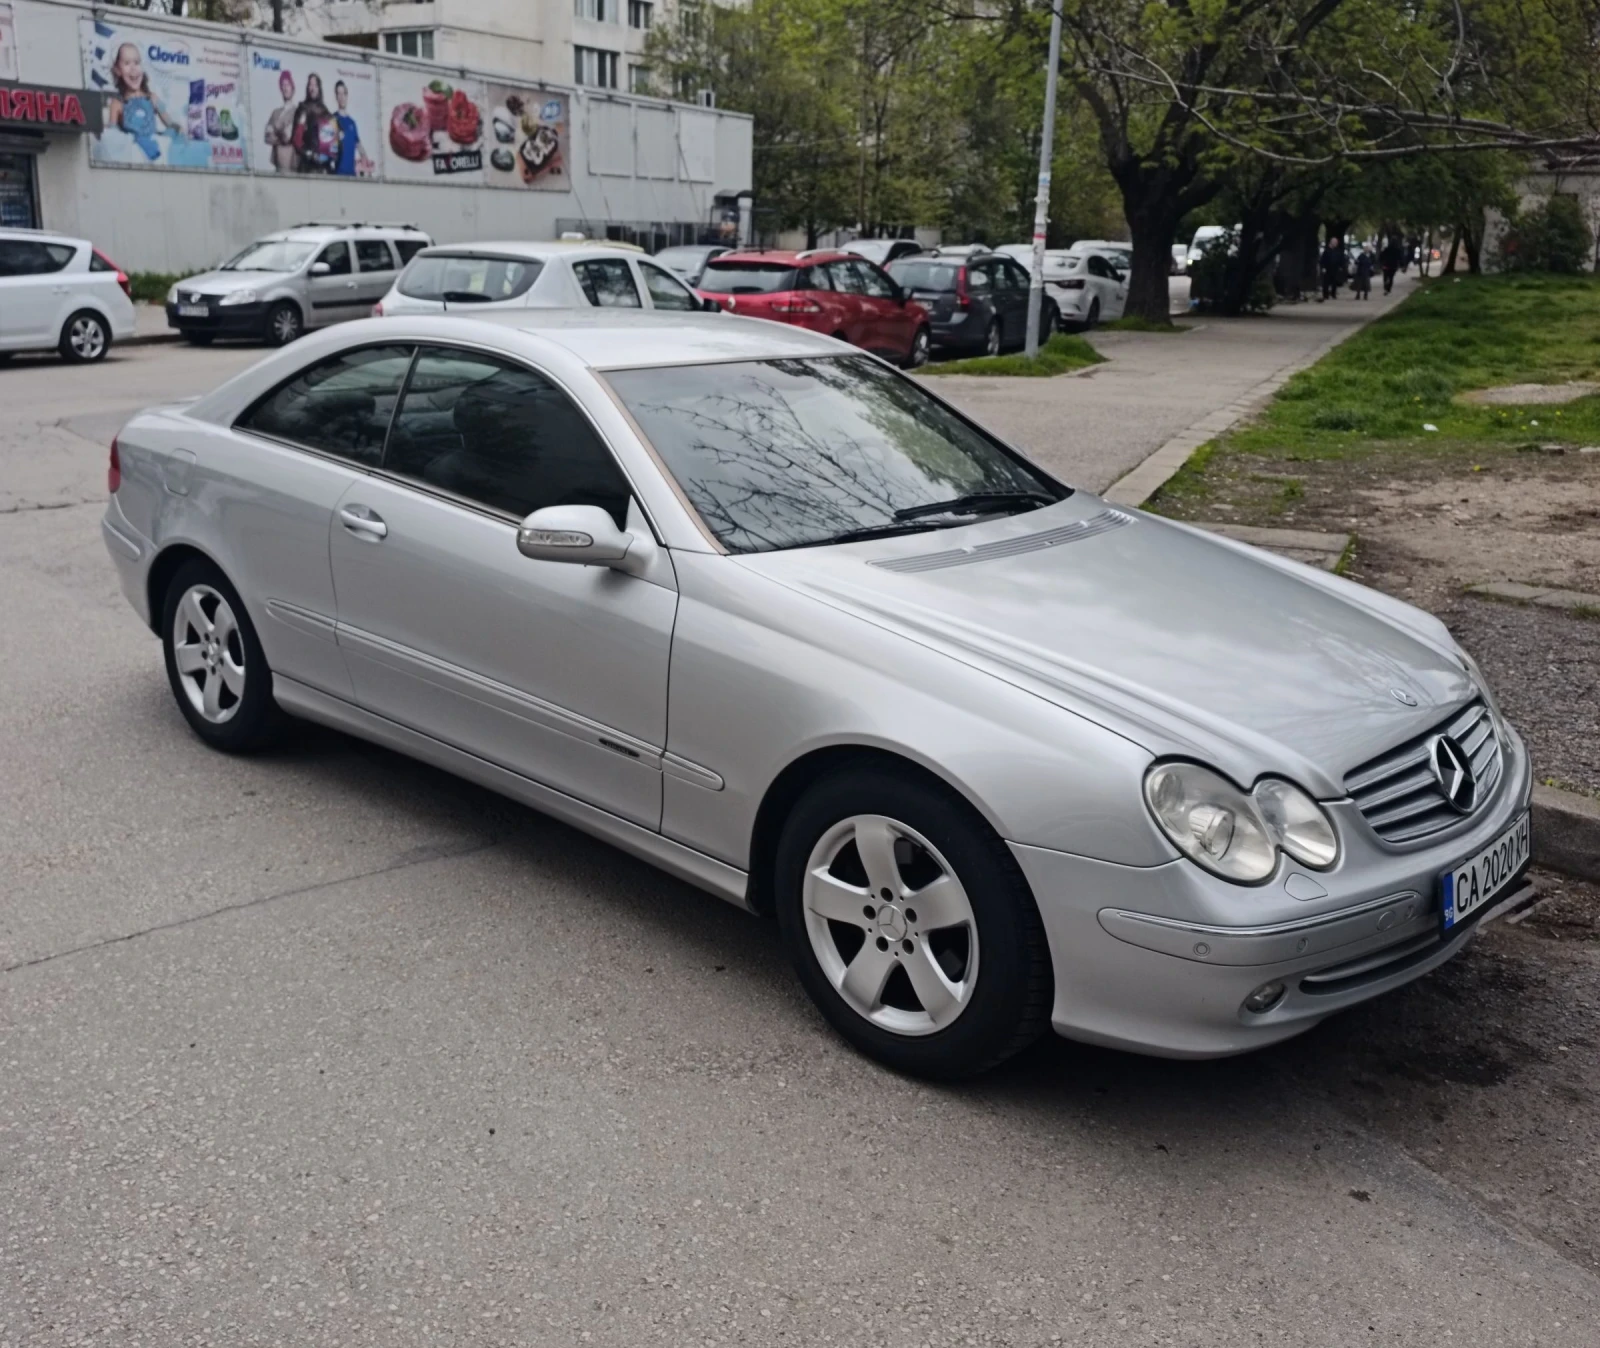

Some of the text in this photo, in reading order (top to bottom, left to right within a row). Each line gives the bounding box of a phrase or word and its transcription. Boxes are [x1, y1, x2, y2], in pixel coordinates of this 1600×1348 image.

[148, 45, 190, 66] Clovin
[1457, 818, 1529, 914] CA 2020 XH
